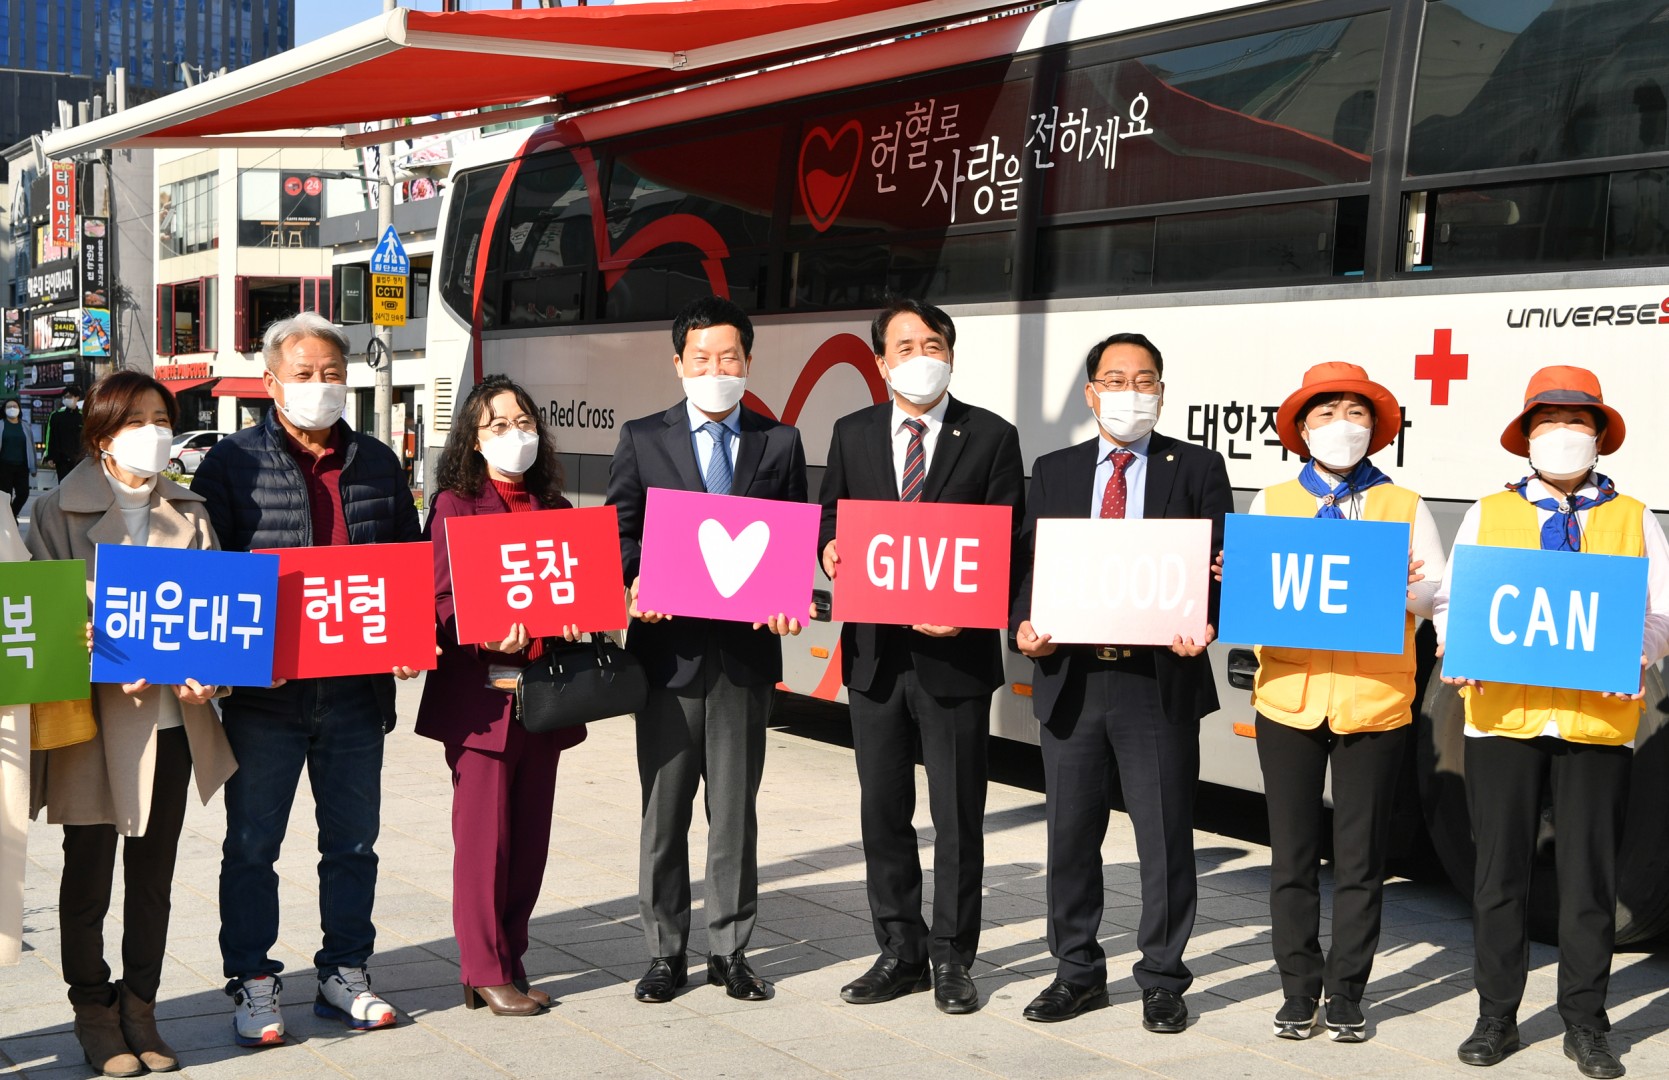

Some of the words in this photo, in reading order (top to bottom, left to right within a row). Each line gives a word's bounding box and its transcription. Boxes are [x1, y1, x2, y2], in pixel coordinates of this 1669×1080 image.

[871, 99, 960, 193] 헌혈로
[921, 136, 1023, 224] 사랑을
[1025, 92, 1154, 170] 전하세요
[56, 170, 70, 242] 타이마사지
[306, 180, 319, 190] 24
[27, 275, 44, 298] 해운대
[44, 268, 73, 294] 타이마사지
[86, 271, 95, 281] 집
[375, 263, 406, 274] 횡단보도
[377, 287, 402, 297] CCTV
[54, 323, 75, 331] 24시간
[374, 312, 390, 322] 24시간
[550, 399, 575, 427] Red
[578, 400, 615, 429] Cross
[500, 539, 578, 609] 동참
[866, 533, 980, 593] GIVE
[1271, 552, 1351, 614] WE
[105, 580, 264, 651] 해운대구
[303, 574, 388, 644] 헌혈
[1489, 584, 1600, 652] CAN
